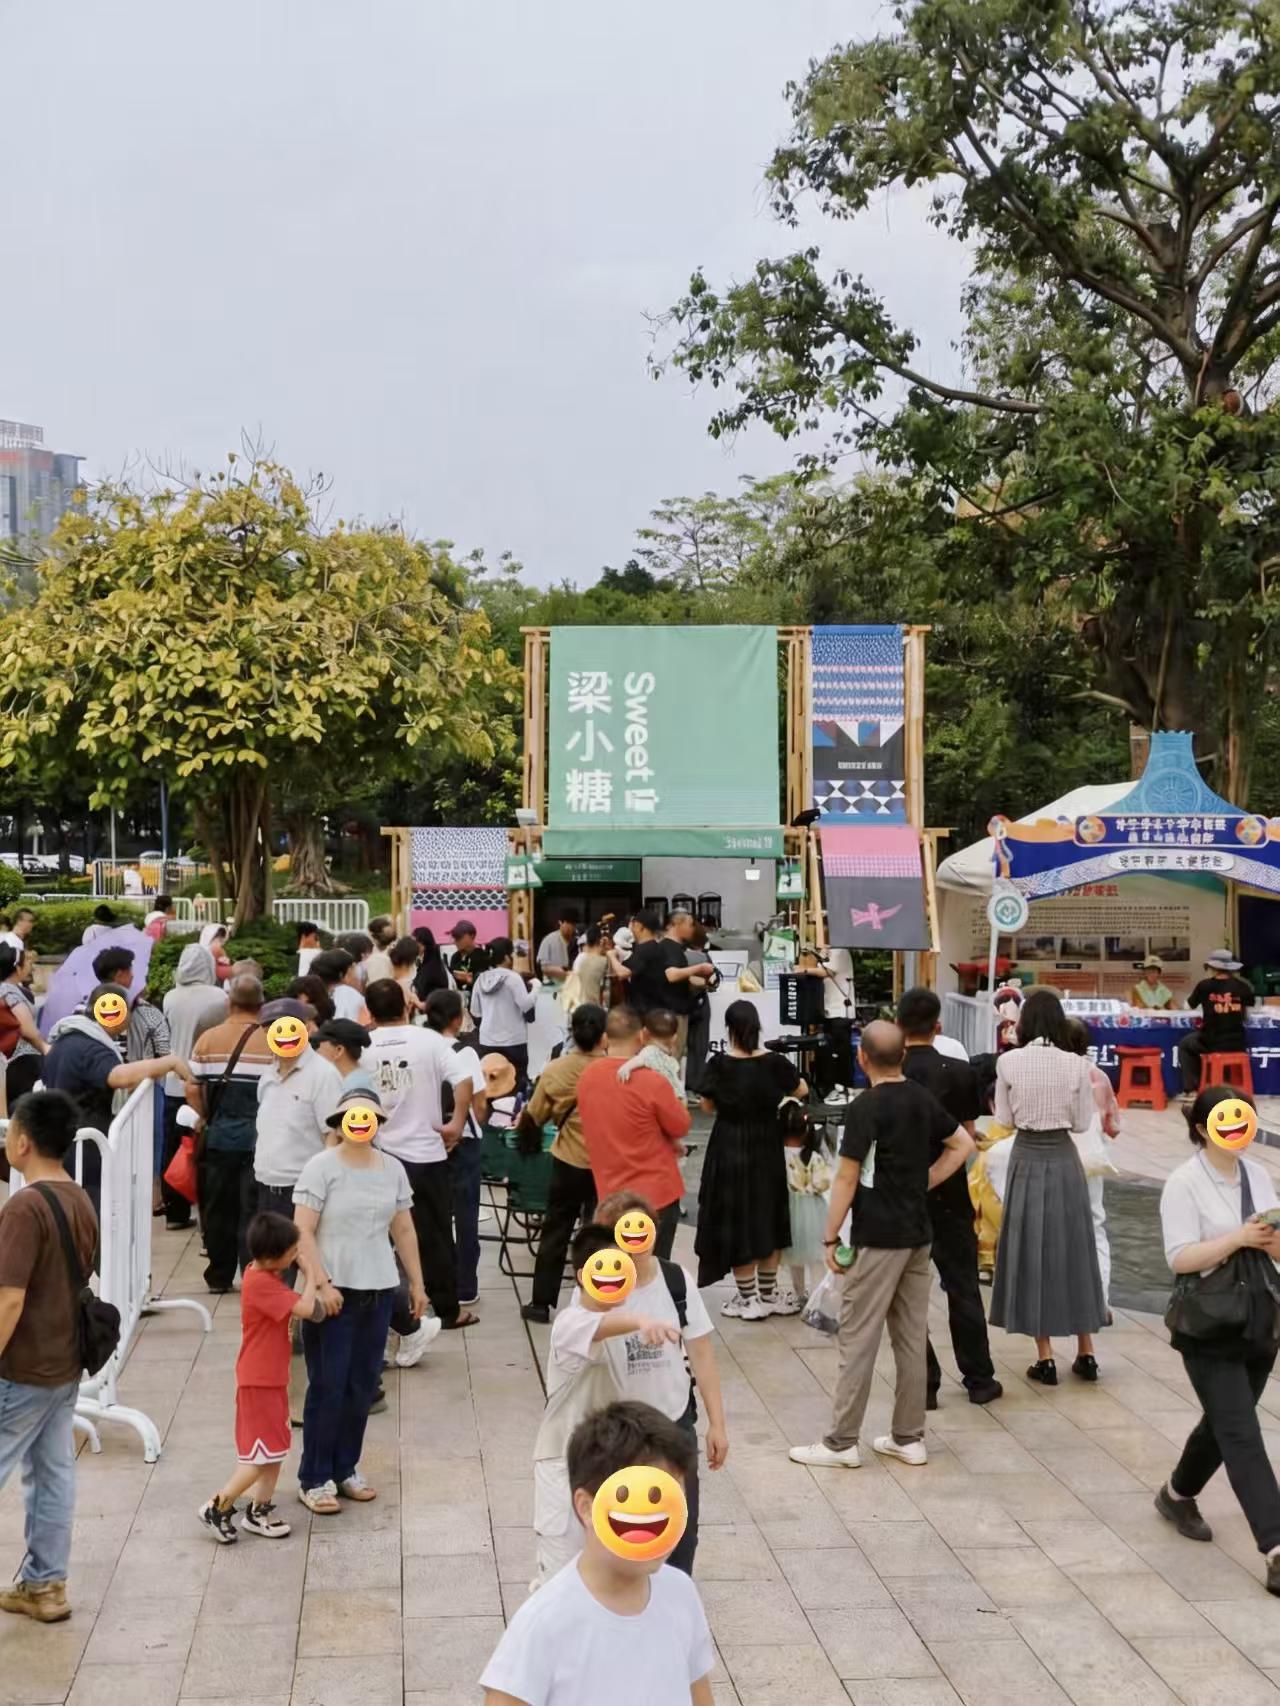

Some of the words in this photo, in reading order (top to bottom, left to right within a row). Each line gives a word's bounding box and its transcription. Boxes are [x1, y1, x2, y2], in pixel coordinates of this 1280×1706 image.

[565, 671, 614, 813] 梁小糖
[624, 671, 656, 783] Sweet
